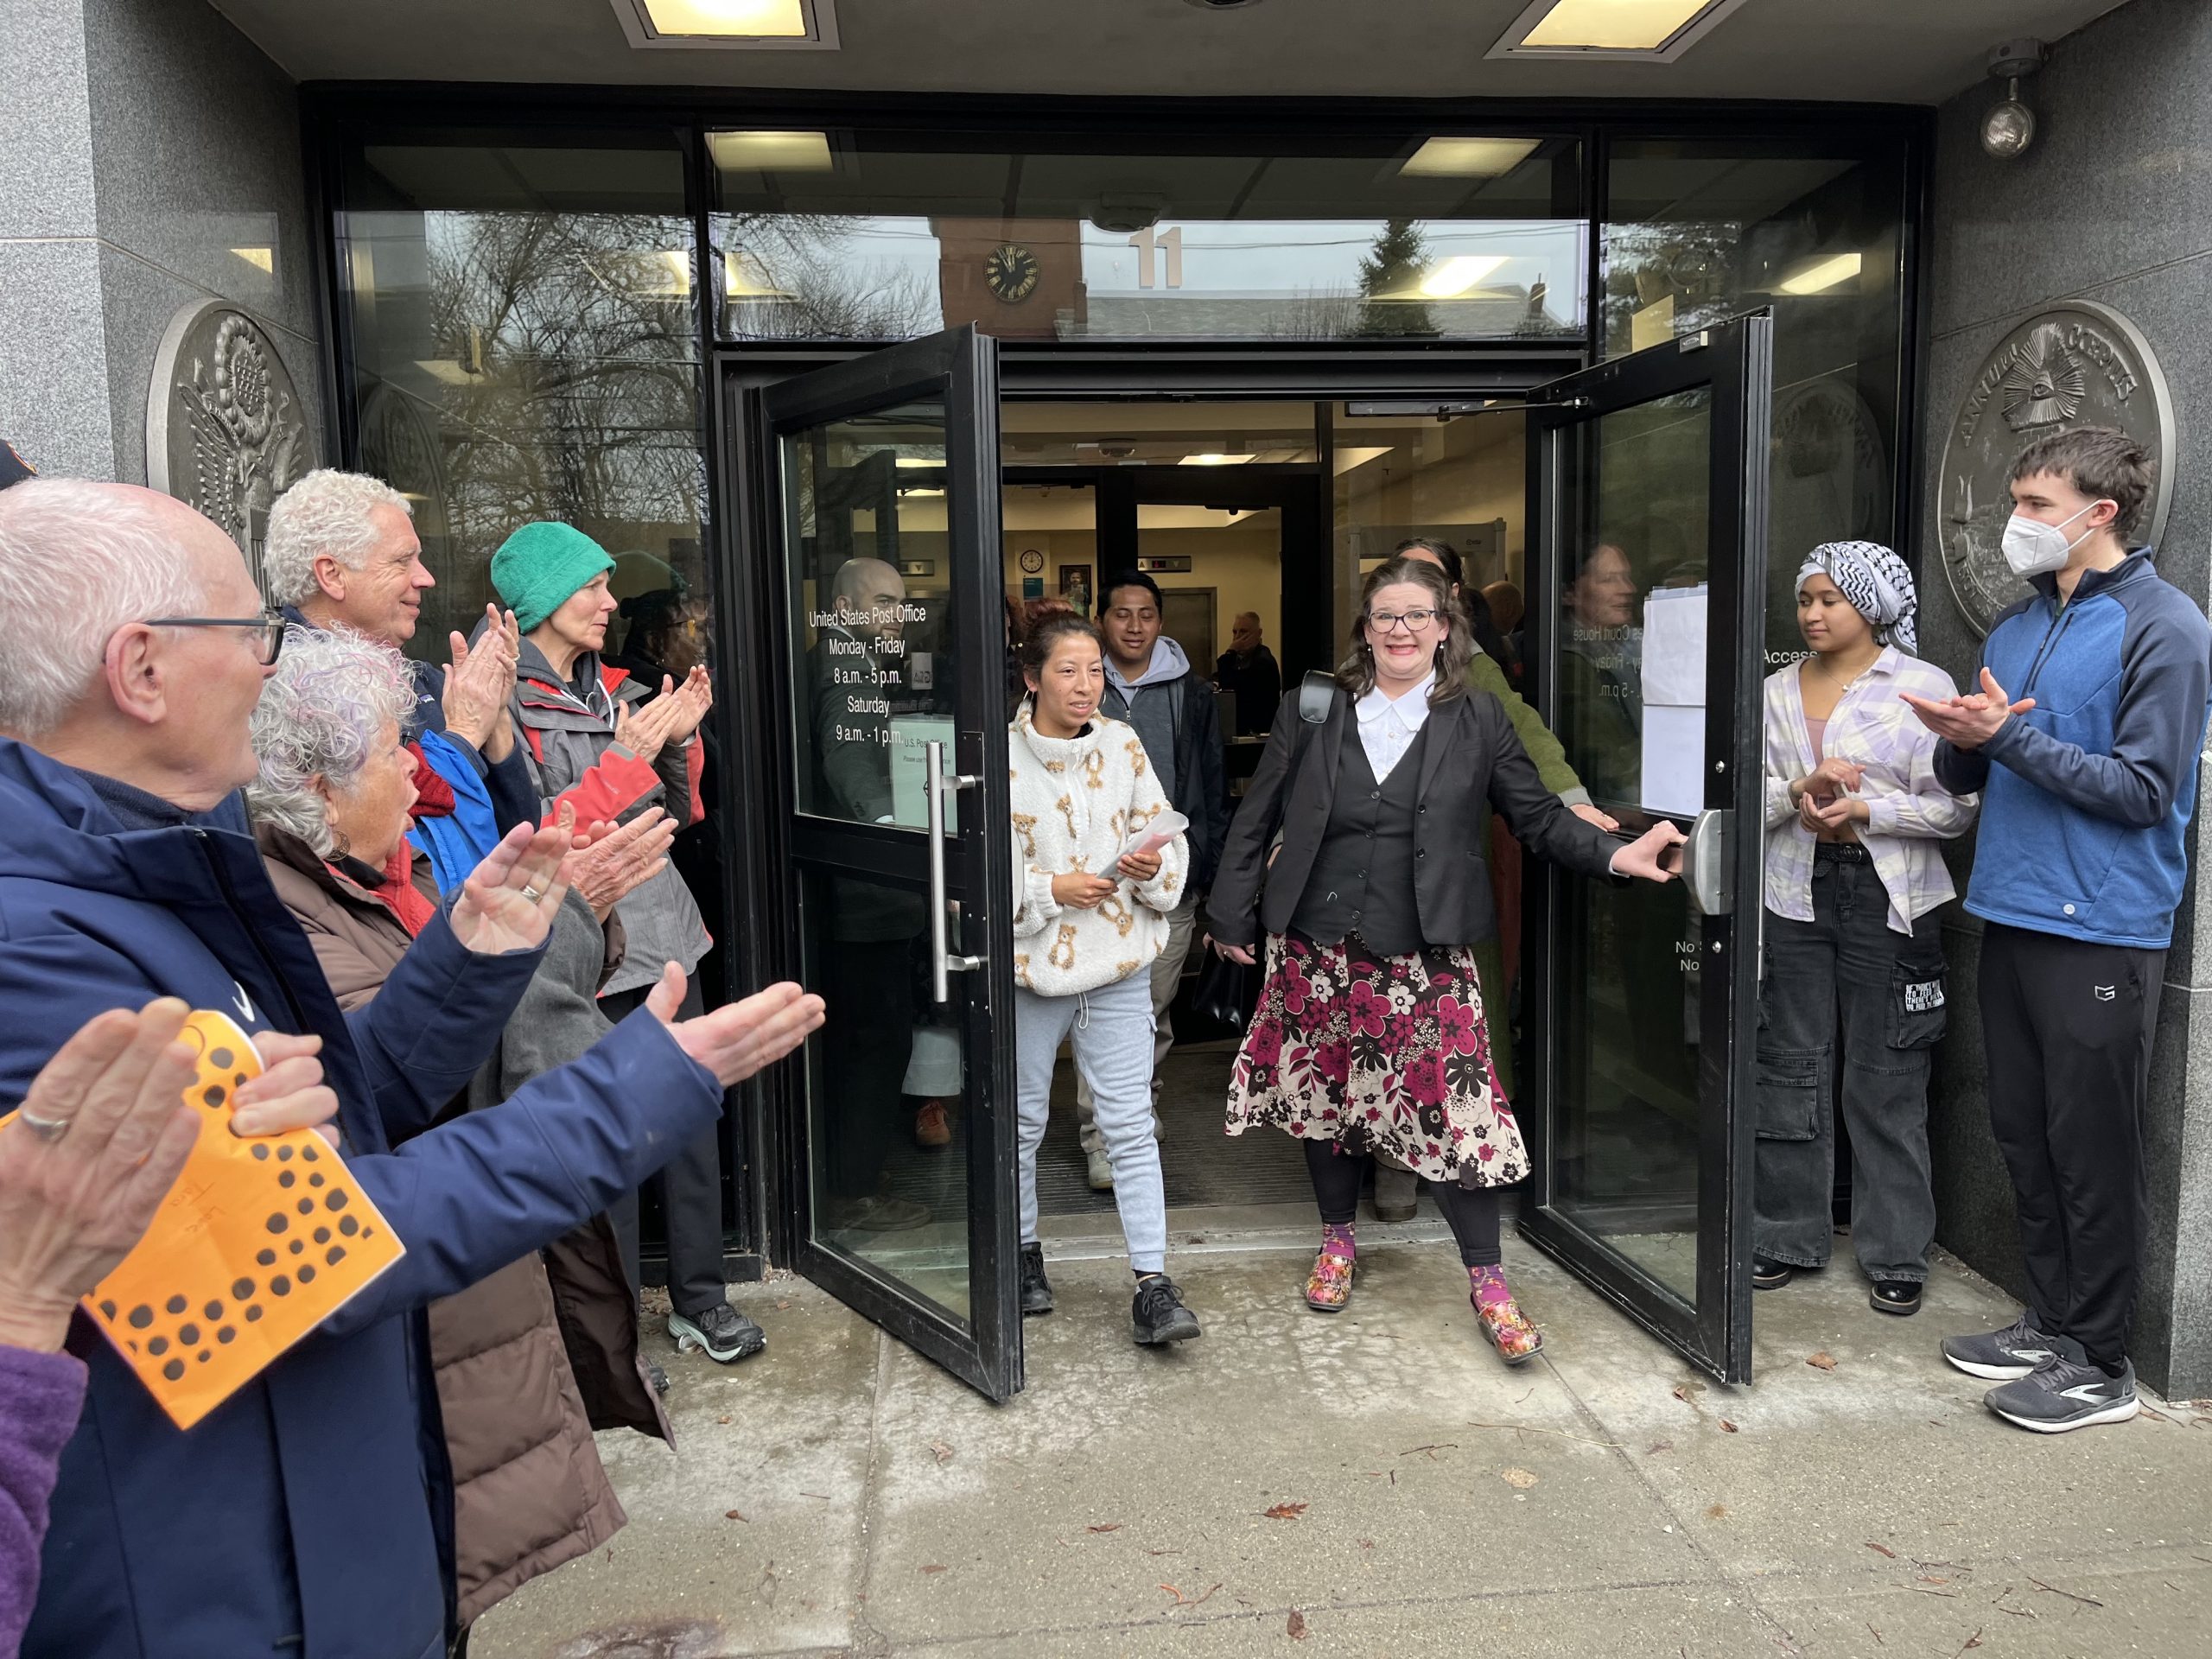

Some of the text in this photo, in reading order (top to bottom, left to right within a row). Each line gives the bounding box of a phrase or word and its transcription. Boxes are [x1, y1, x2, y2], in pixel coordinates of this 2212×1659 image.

[1128, 226, 1182, 289] 11
[809, 604, 926, 627] United States Post Office
[830, 639, 867, 659] Monday
[874, 636, 906, 658] Friday
[834, 667, 840, 683] 8
[842, 669, 862, 683] a.m.
[871, 667, 878, 684] 5
[880, 669, 902, 688] p.m.
[847, 695, 890, 718] Saturday
[836, 724, 842, 741] 9
[844, 726, 865, 742] a.m.
[874, 726, 879, 743] 1
[881, 729, 904, 747] p.m.
[904, 737, 916, 748] U.S.
[1675, 941, 1695, 953] No
[1680, 959, 1700, 971] No
